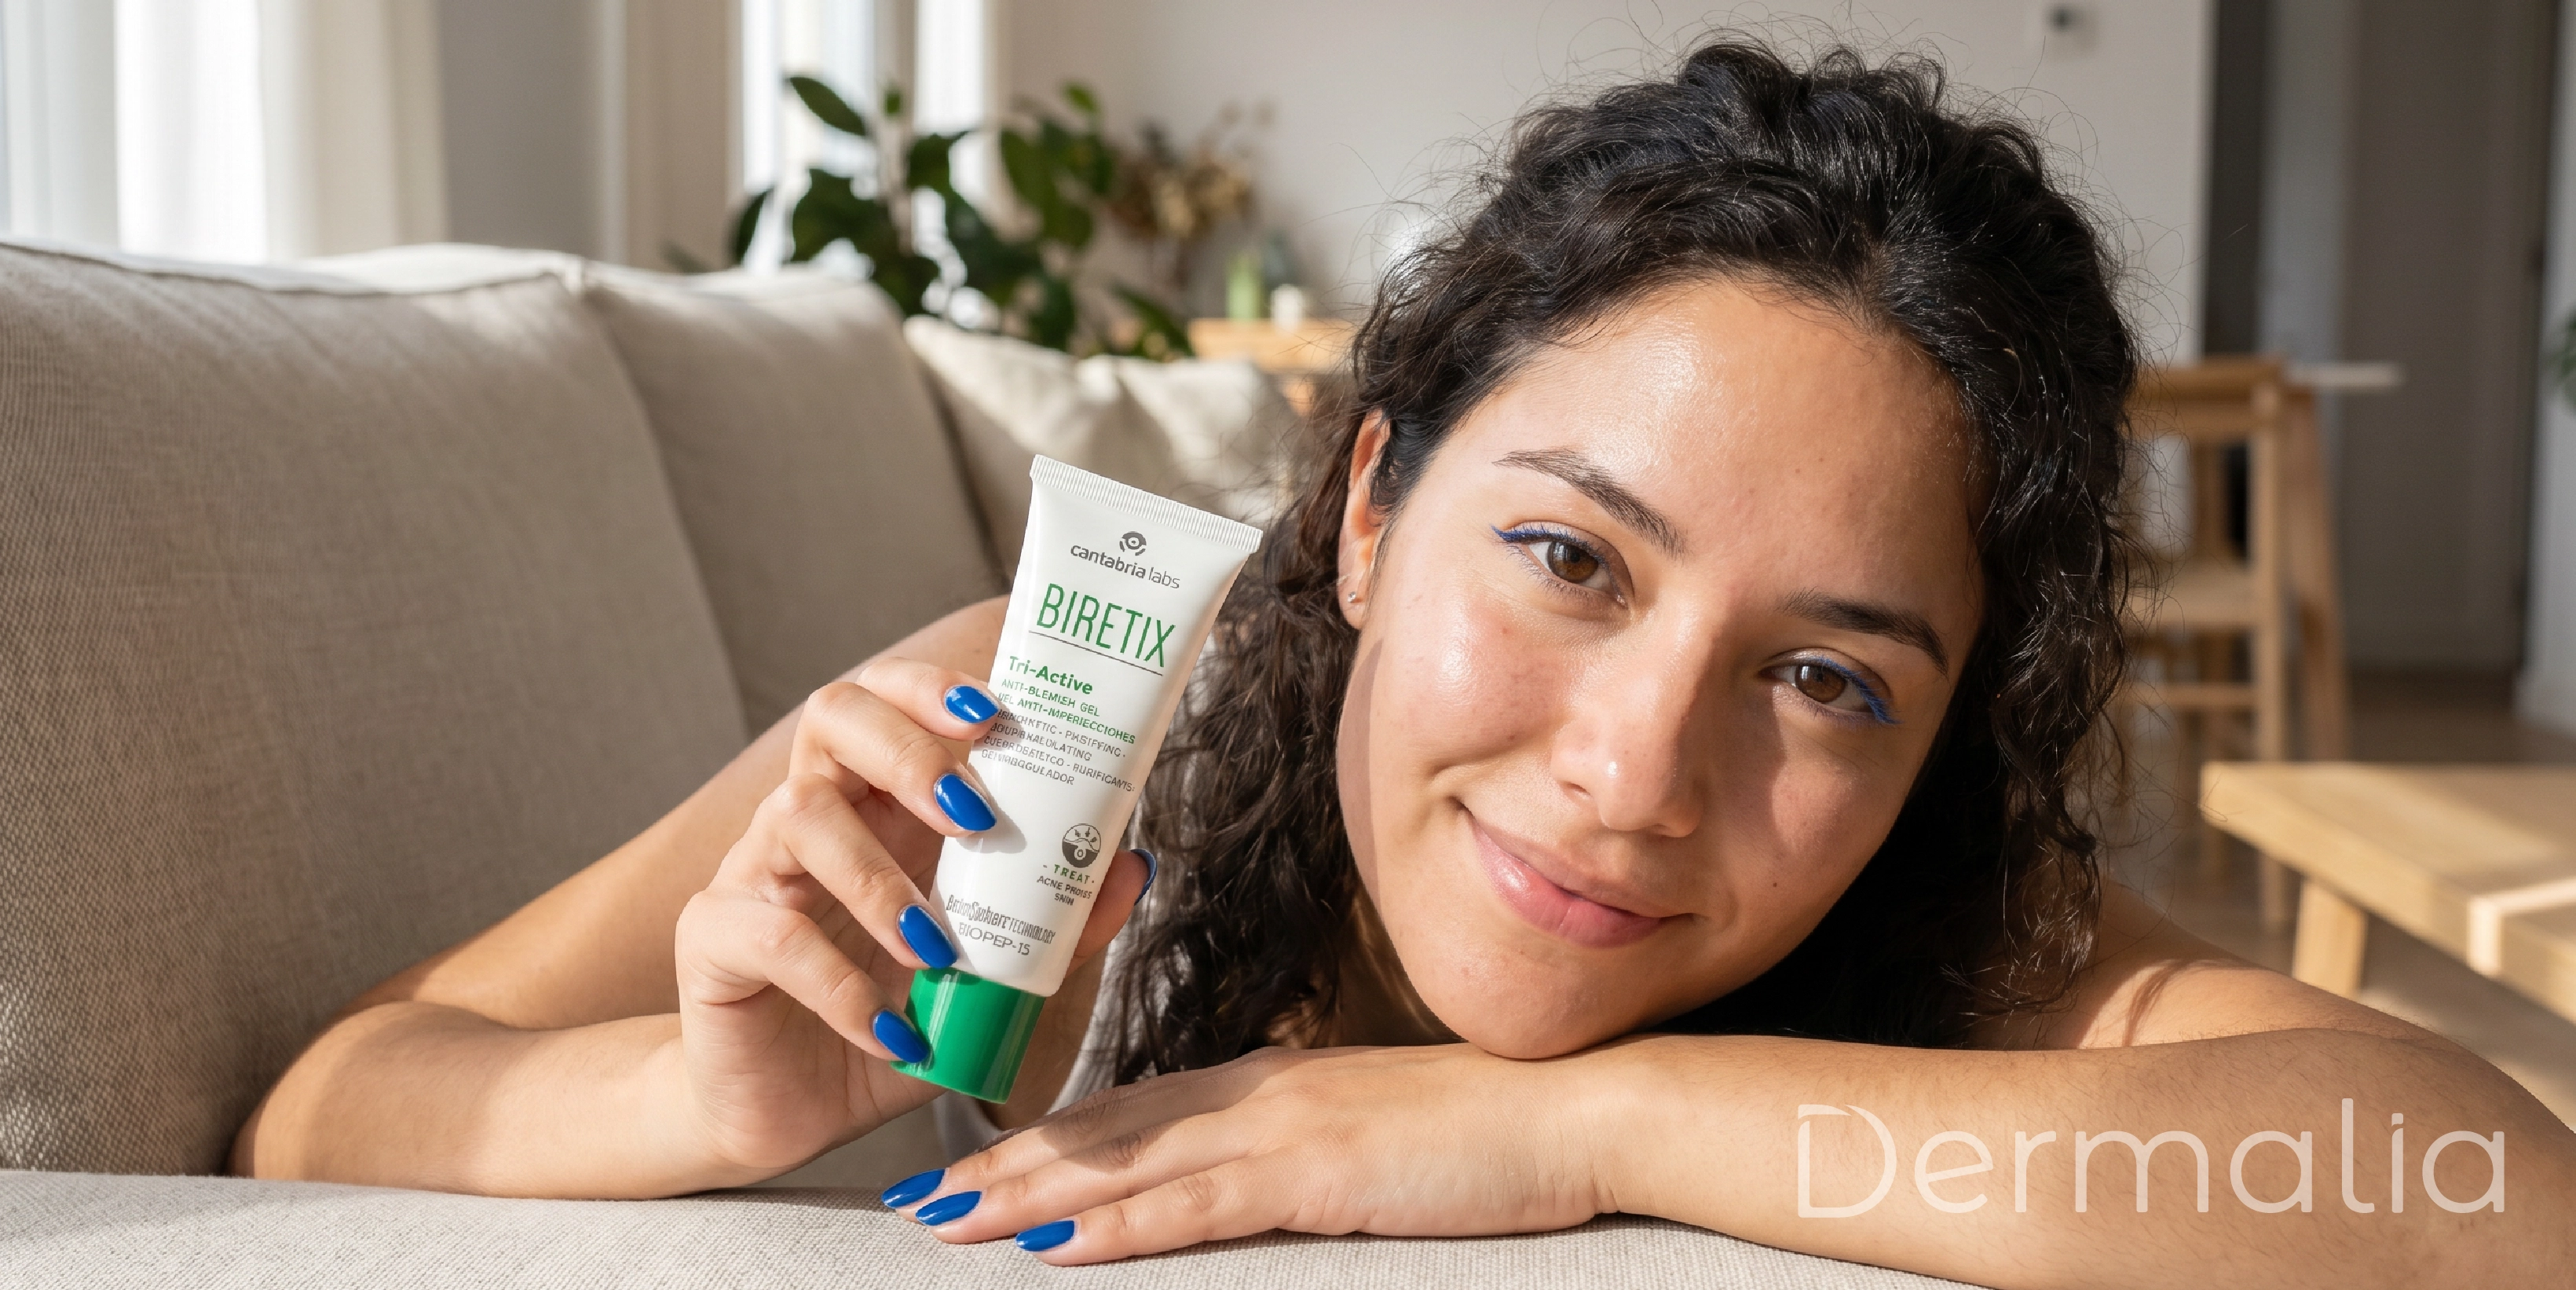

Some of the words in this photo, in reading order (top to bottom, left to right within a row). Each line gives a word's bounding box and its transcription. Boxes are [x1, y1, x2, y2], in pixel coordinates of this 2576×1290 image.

[1070, 544, 1146, 578] cantabria
[1148, 567, 1180, 588] labs
[1037, 583, 1176, 667] BIRETIX
[1009, 656, 1092, 694] Tri-Active
[1081, 702, 1100, 716] GEL
[1037, 875, 1063, 890] ACNE
[1054, 864, 1090, 884] TREAT
